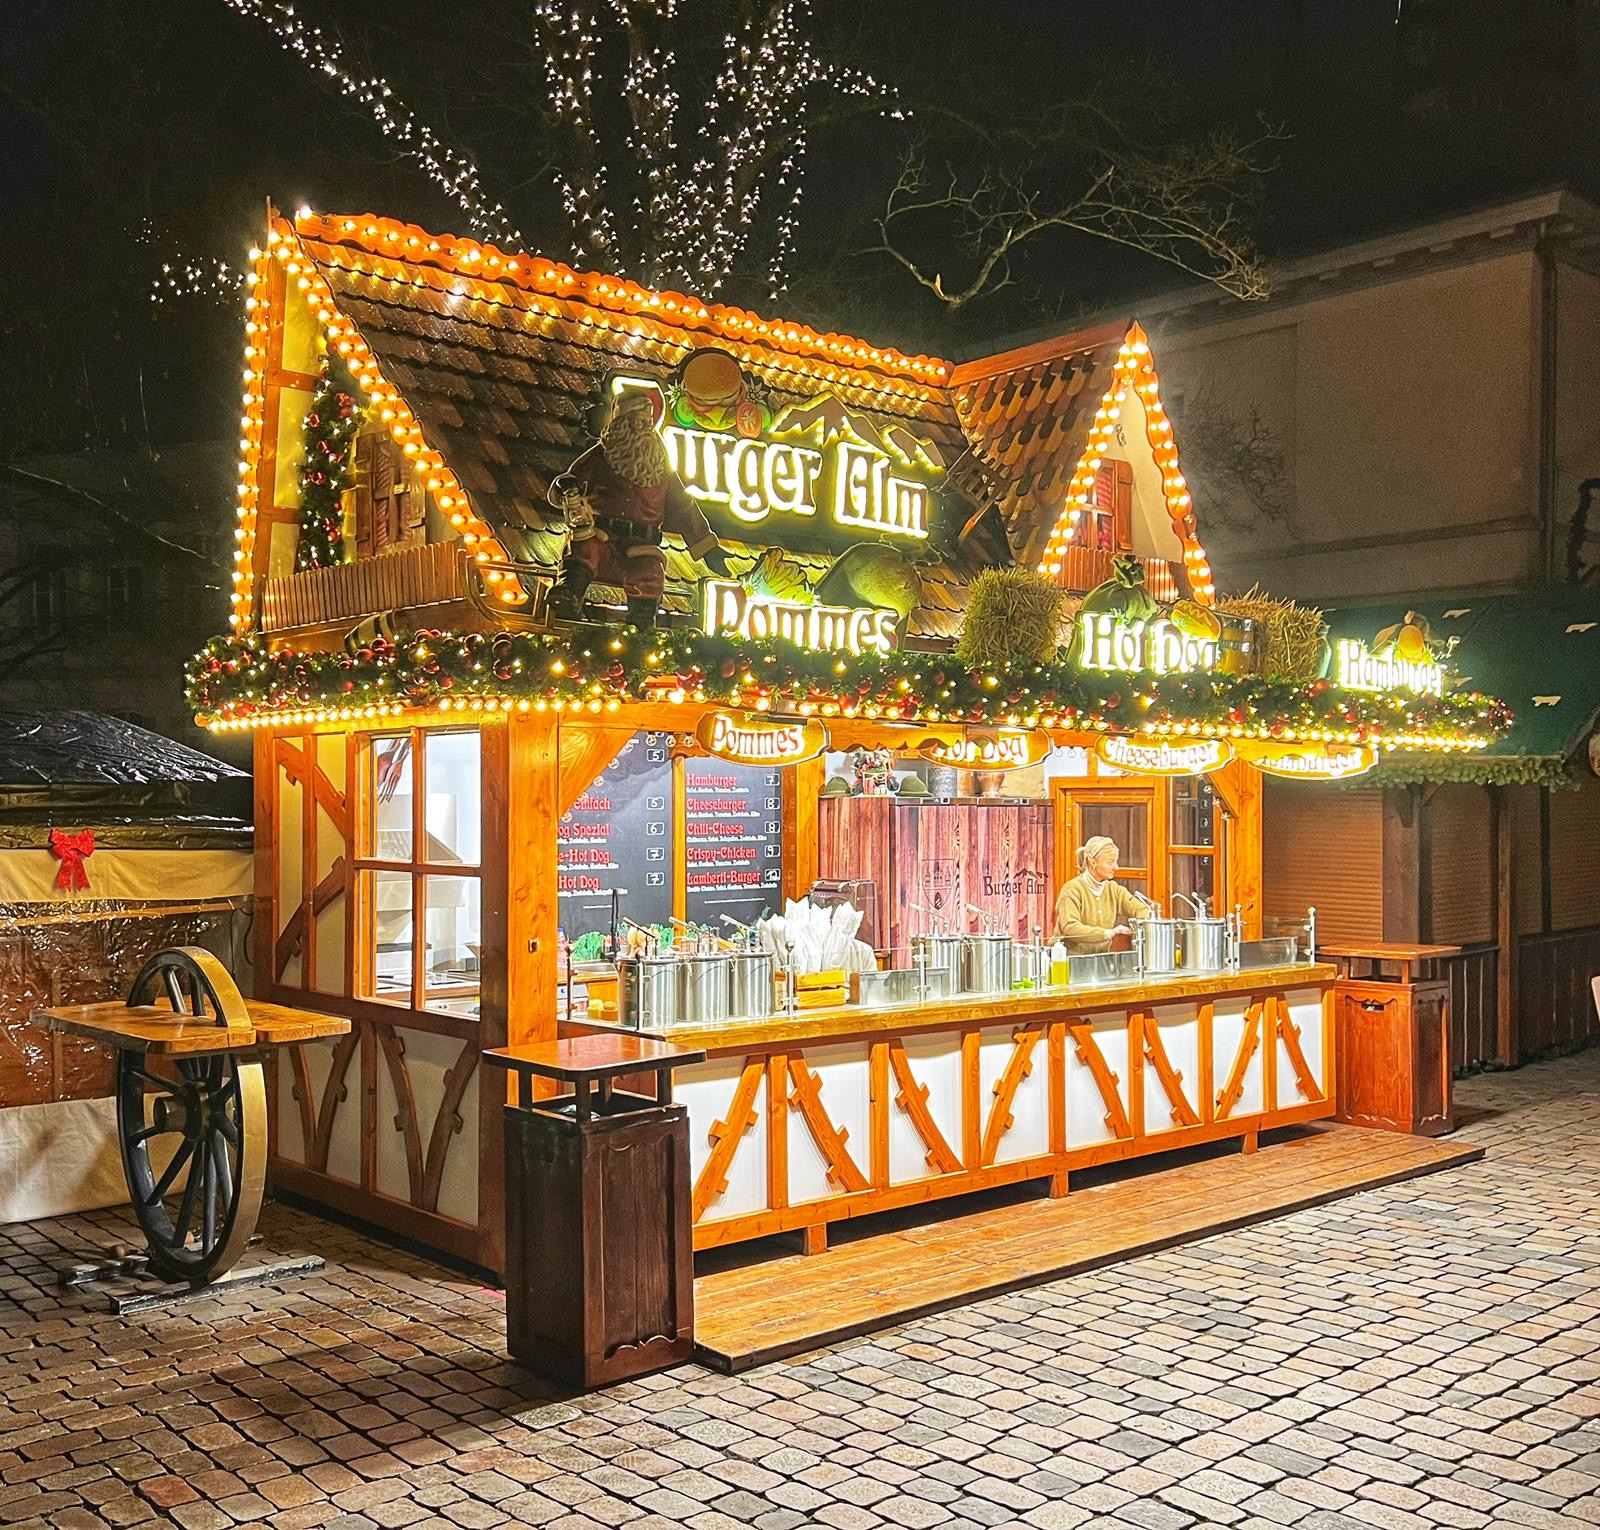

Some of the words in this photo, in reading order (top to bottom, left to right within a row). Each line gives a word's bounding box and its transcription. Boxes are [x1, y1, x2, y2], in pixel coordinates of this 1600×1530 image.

[836, 441, 930, 539] Alm
[703, 578, 900, 658] Pommes
[708, 714, 805, 757] Pommes
[1104, 736, 1219, 772] Cheeseburger
[687, 773, 737, 787] Hamburger
[687, 798, 747, 812] Cheeseburger
[558, 827, 570, 838] og
[573, 822, 610, 837] Spezial
[687, 822, 744, 835] Chili-Cheese
[558, 848, 588, 862] e-Hot
[590, 848, 610, 864] Dog
[687, 846, 757, 861] Crispy-Chicken
[580, 874, 599, 890] Dog
[687, 870, 761, 885] Lamberti-Burger
[983, 875, 1022, 897] Burger
[1026, 878, 1046, 895] Alm
